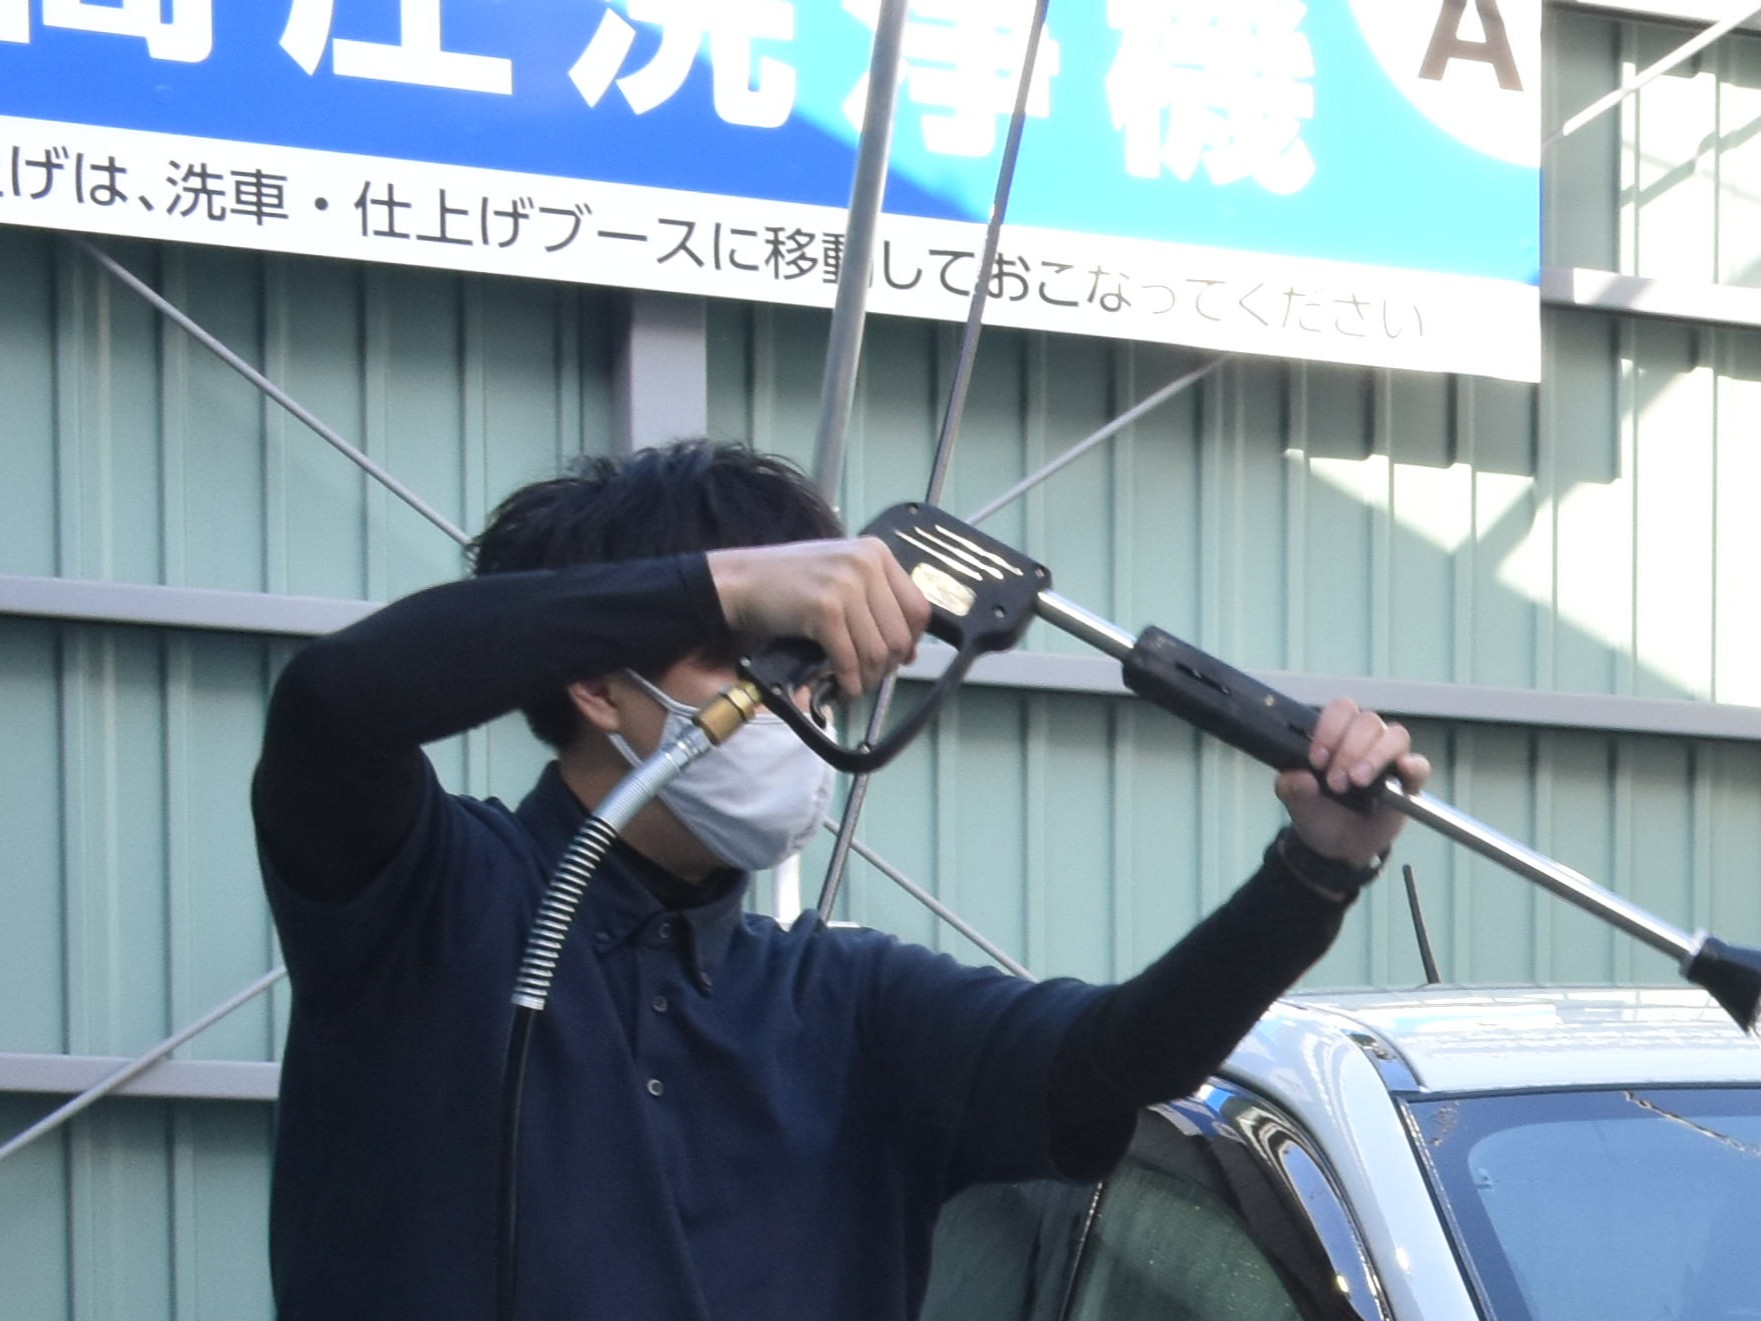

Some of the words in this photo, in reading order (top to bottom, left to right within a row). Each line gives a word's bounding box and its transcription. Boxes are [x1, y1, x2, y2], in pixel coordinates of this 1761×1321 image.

[1418, 0, 1524, 91] A
[0, 145, 1423, 339] げは、洗車・仕上げブースに移しておこなってください
